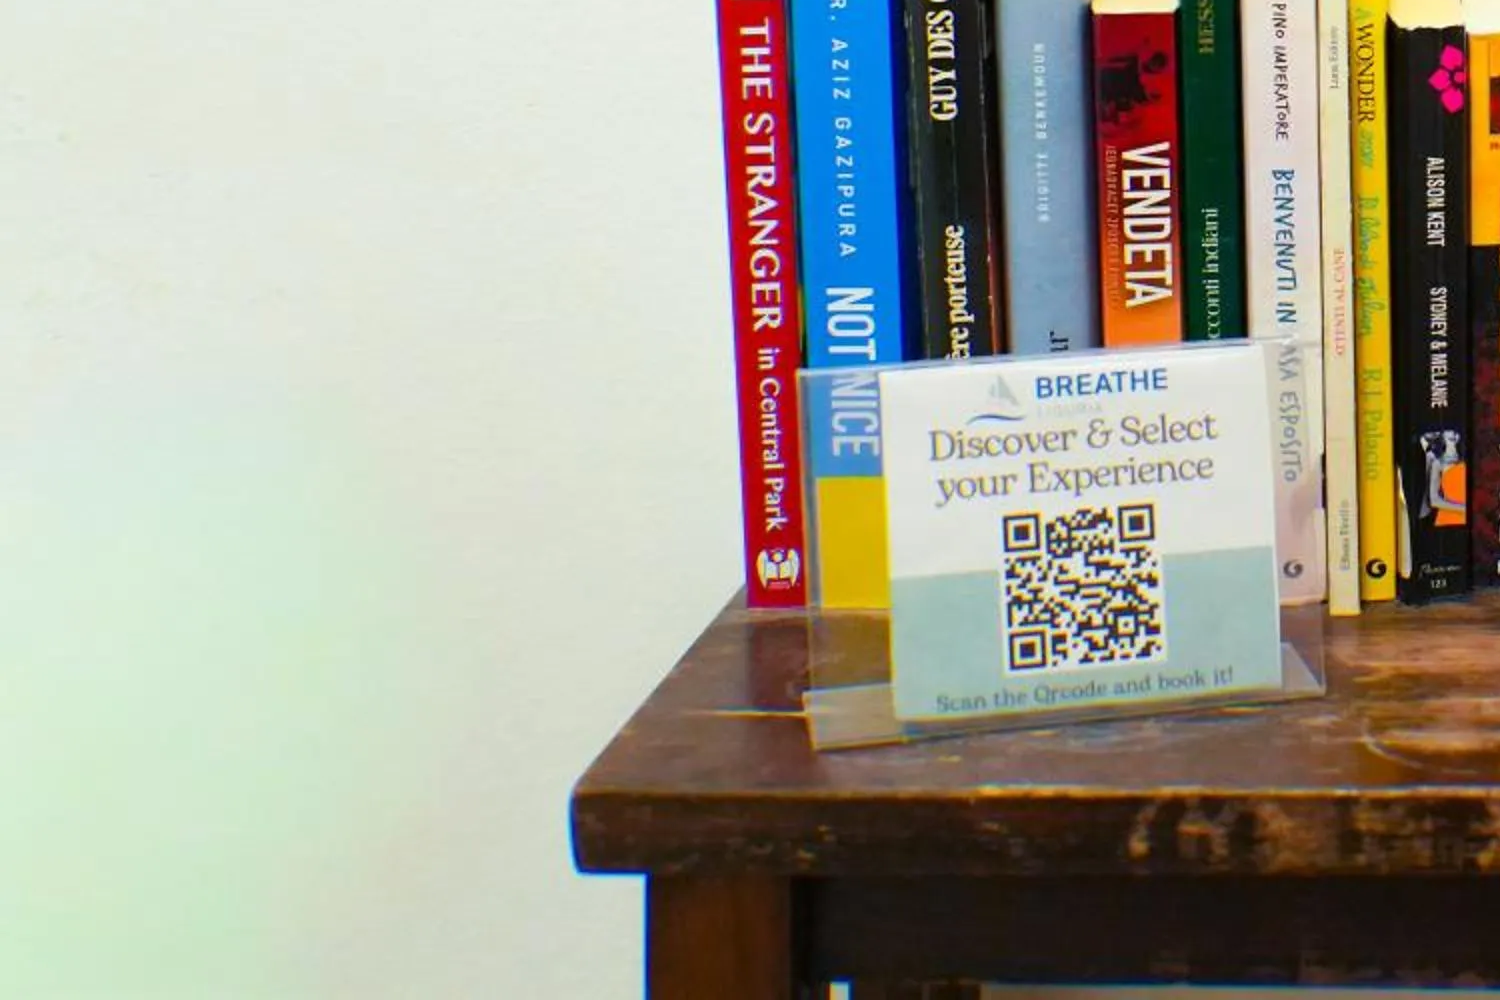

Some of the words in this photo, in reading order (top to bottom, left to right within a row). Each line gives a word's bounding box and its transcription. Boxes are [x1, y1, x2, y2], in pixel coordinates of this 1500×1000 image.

[925, 8, 956, 60] DES
[1271, 3, 1287, 39] PINO
[739, 17, 774, 100] THE
[831, 38, 850, 100] AZIZ
[1355, 23, 1376, 124] WONDER
[929, 62, 959, 122] GUY
[1272, 45, 1289, 141] IMPERATORE
[834, 117, 858, 258] GAZIPURA
[1427, 156, 1446, 209] ALISON
[743, 112, 782, 333] STRANGER
[1121, 141, 1173, 309] VENDETA
[1200, 207, 1219, 273] indiani
[1271, 168, 1297, 292] BENVENUTI
[1427, 211, 1446, 246] KENT
[944, 225, 976, 324] porteuse
[825, 287, 877, 361] NOT
[1202, 277, 1220, 340] cconti
[1275, 302, 1297, 323] IN
[1429, 286, 1448, 337] SYDNEY
[756, 348, 781, 371] in
[944, 326, 971, 361] ère
[1278, 330, 1301, 381] ASA
[1430, 340, 1448, 351] &
[1036, 368, 1168, 399] BREATHE
[1430, 353, 1448, 410] MELANIE
[758, 376, 785, 471] Central
[831, 371, 880, 457] NICE
[928, 428, 1078, 462] Discover
[1086, 418, 1114, 449] &
[1120, 413, 1219, 446] Select
[1279, 394, 1303, 483] ESPOSITO
[763, 478, 789, 532] Park
[935, 471, 1018, 508] your
[1028, 457, 1214, 497] Experience
[935, 693, 987, 713] Scan
[993, 690, 1027, 707] the
[1033, 680, 1107, 705] Qrcode
[1113, 675, 1151, 694] and
[1157, 670, 1206, 690] book
[1213, 665, 1234, 684] it!
